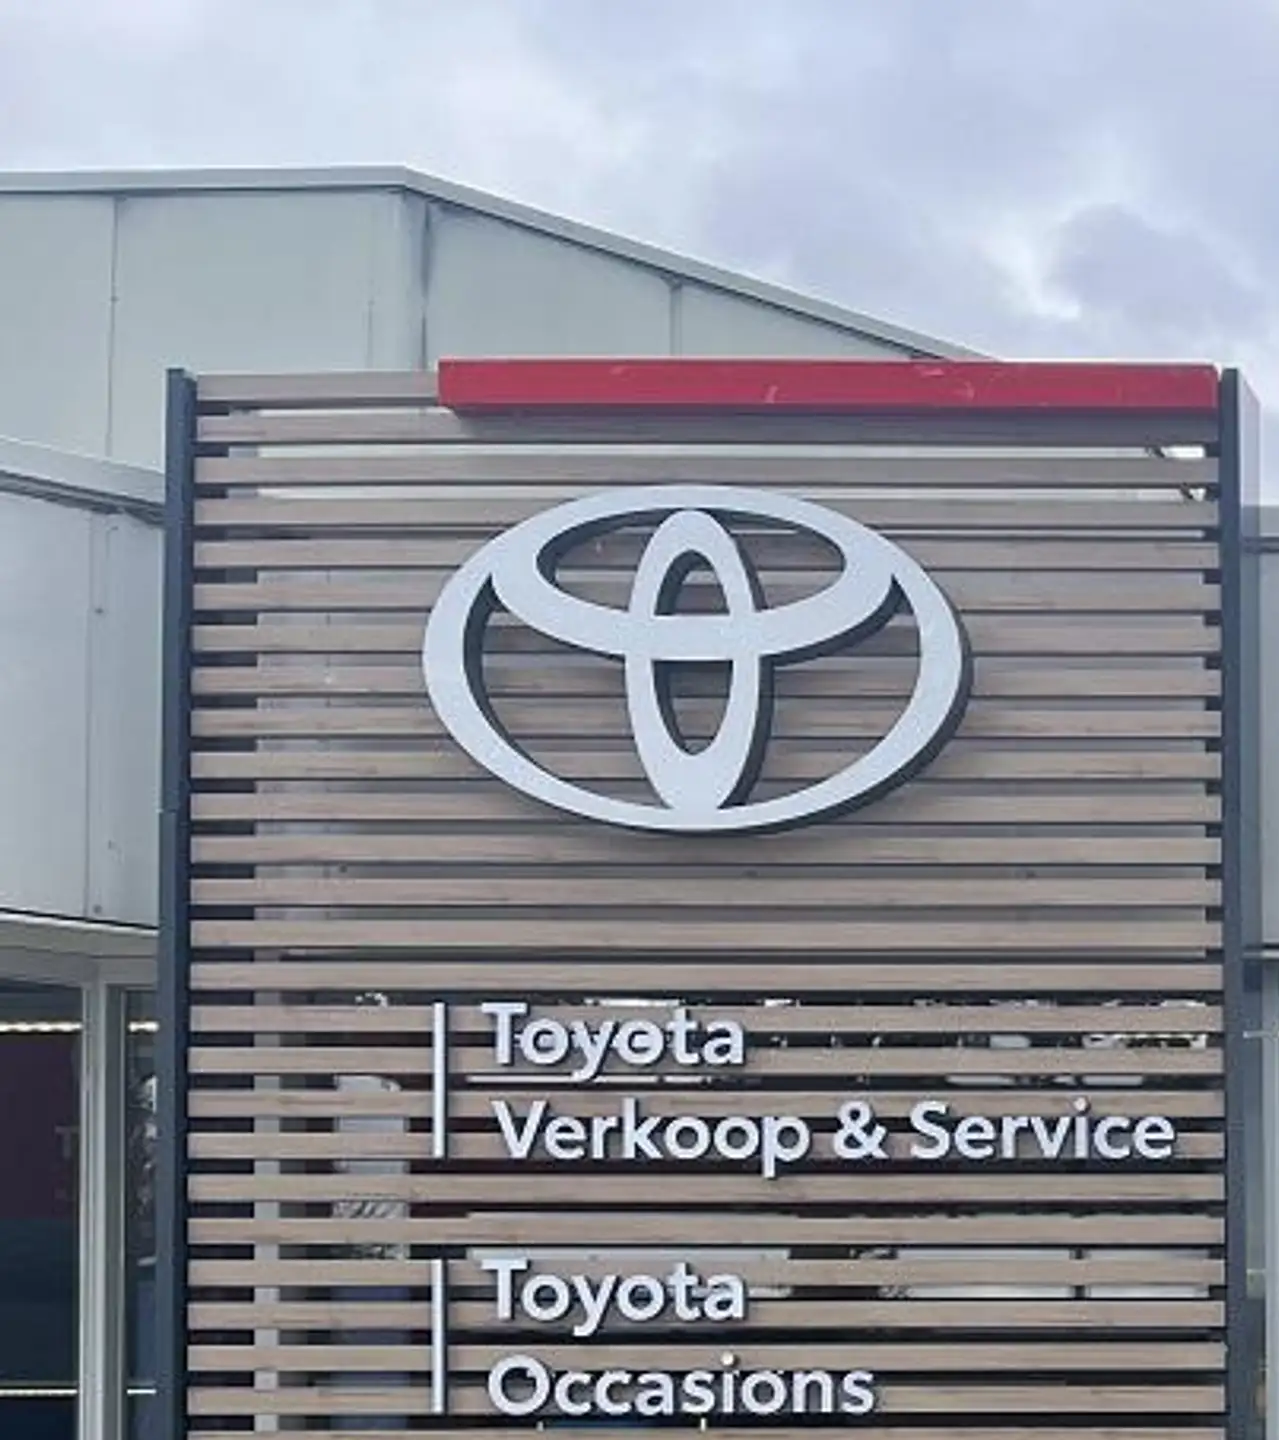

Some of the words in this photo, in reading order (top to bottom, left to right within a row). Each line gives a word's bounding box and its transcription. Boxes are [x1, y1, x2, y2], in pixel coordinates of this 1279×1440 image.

[480, 1001, 745, 1081] Toyota
[491, 1097, 812, 1178] Verkoop
[832, 1099, 888, 1159] &
[910, 1095, 1177, 1160] Service
[480, 1258, 746, 1336] Toyota
[487, 1351, 875, 1415] Occasions
